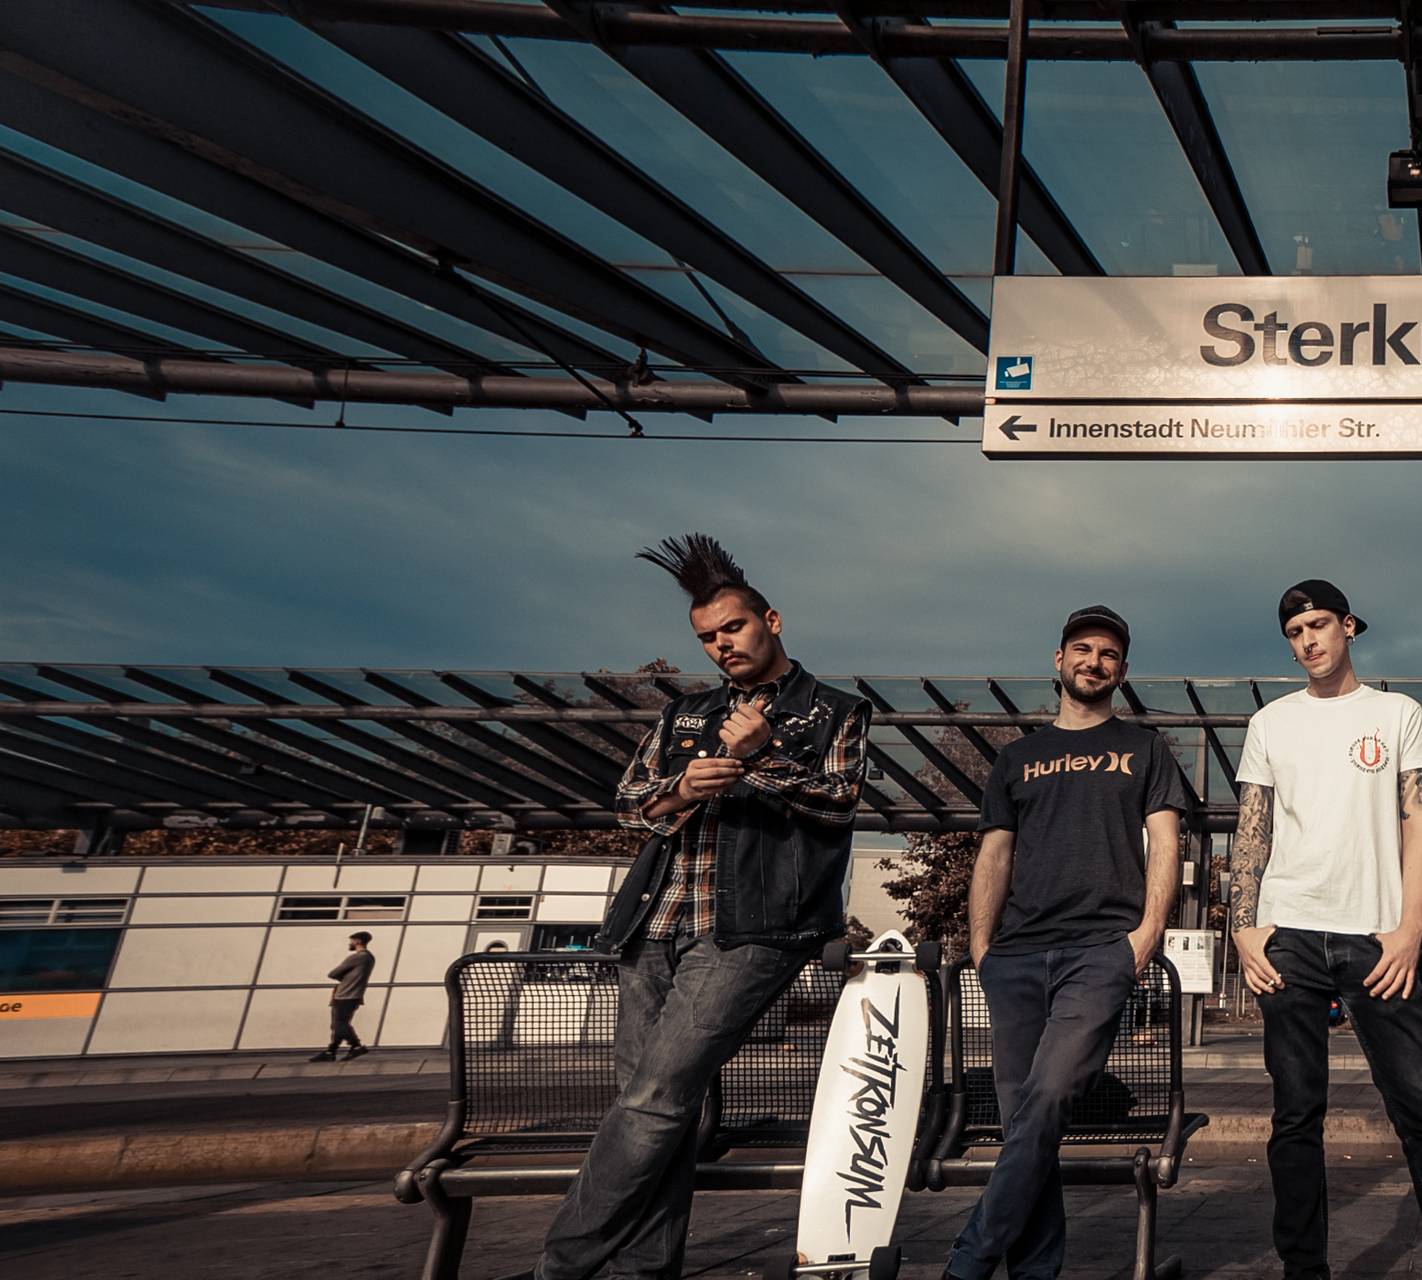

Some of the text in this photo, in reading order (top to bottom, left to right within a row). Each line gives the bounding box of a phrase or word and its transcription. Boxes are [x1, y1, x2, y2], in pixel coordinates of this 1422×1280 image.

[1049, 417, 1184, 438] Innenstadt
[1338, 417, 1381, 438] Str.
[1023, 753, 1104, 782] Hurley
